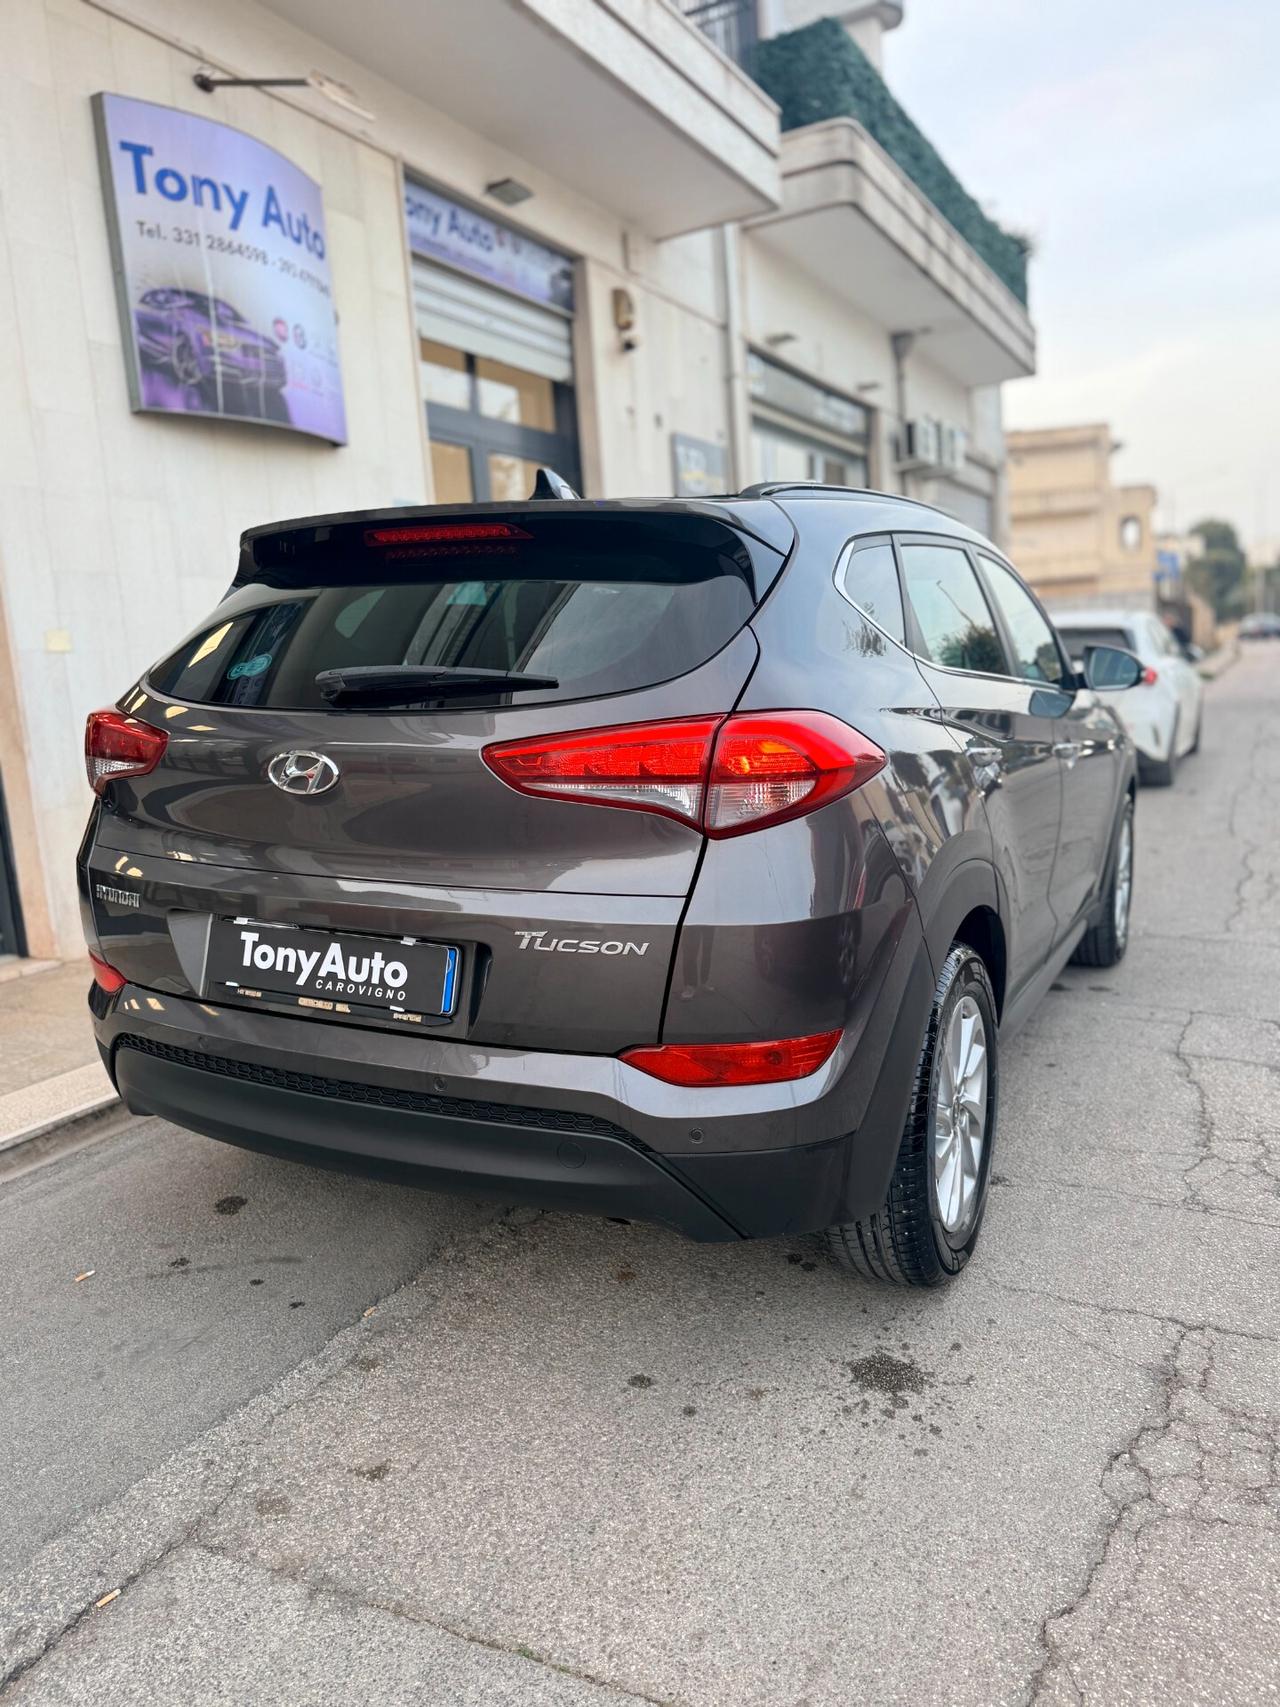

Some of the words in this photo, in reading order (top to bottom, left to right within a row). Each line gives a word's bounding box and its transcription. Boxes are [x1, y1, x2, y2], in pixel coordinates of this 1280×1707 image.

[119, 140, 249, 231] Tony
[262, 184, 326, 261] Auto
[136, 220, 167, 241] Tel.
[173, 227, 200, 247] 331
[405, 194, 441, 238] ony
[448, 207, 495, 252] Auto
[96, 884, 141, 908] HYUNDAI
[240, 931, 409, 988] TonyAuto
[315, 979, 407, 1002] CAROVIGNO
